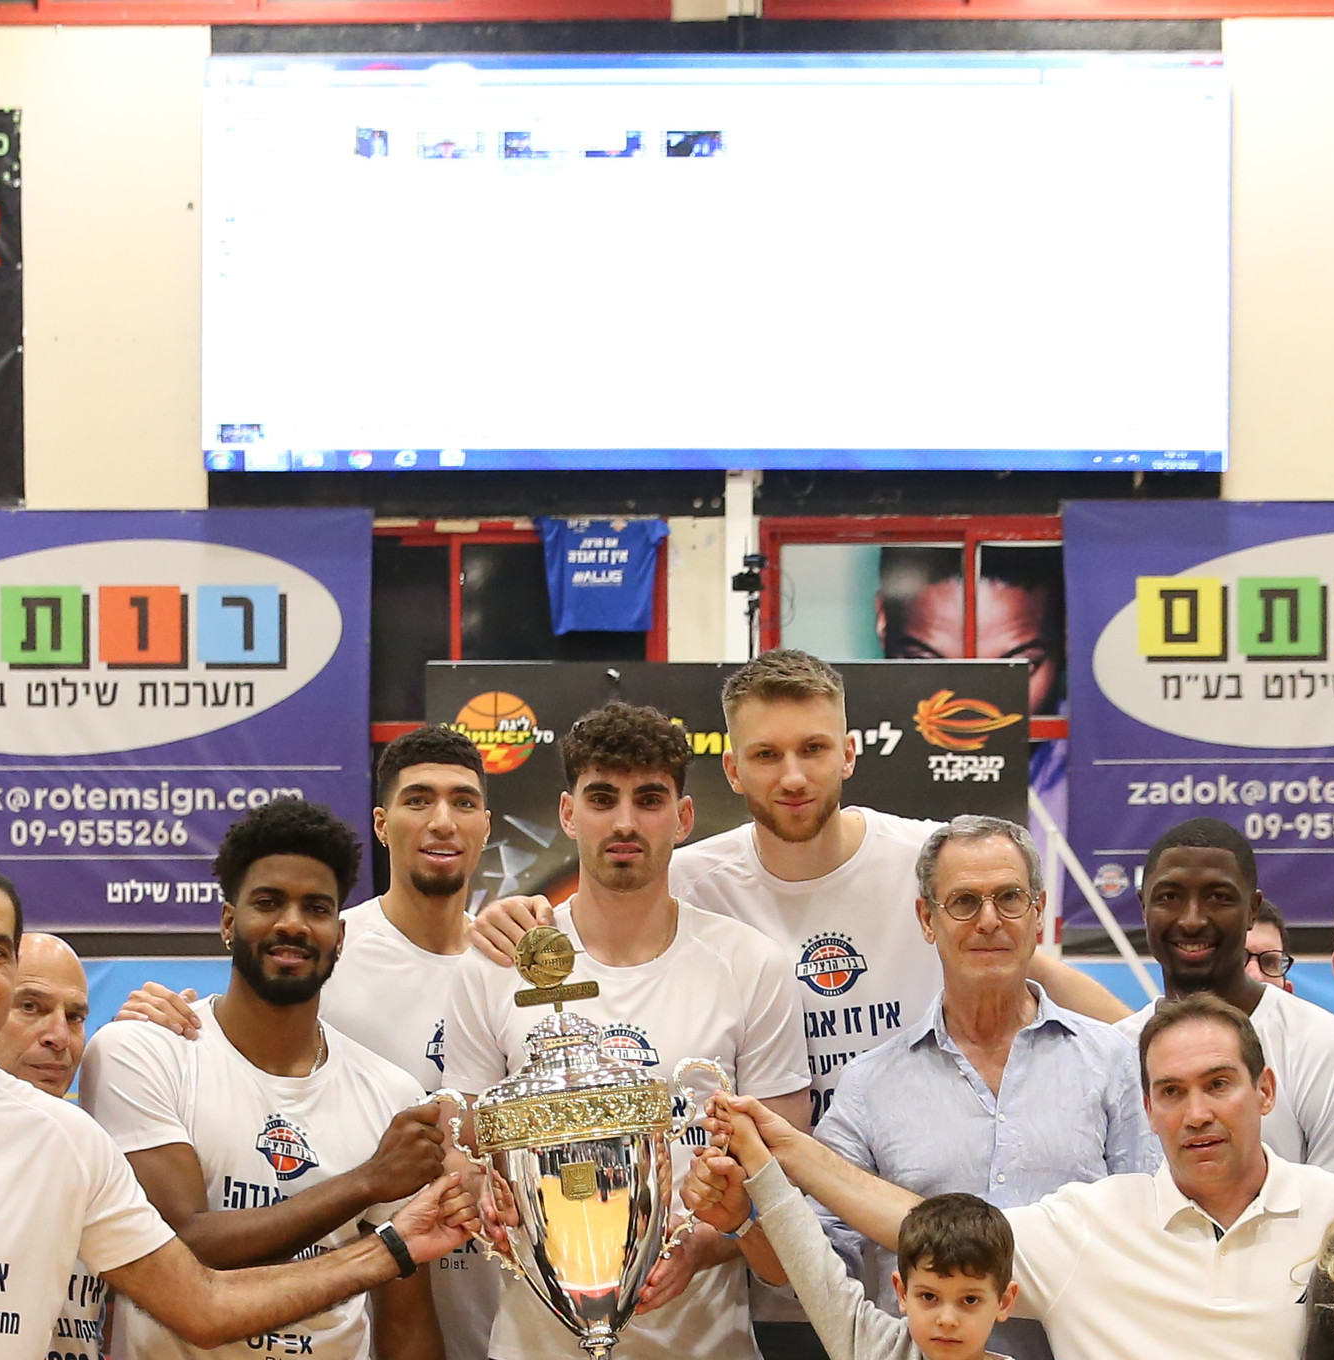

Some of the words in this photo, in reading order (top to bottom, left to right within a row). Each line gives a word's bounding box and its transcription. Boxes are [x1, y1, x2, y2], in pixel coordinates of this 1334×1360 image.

[27, 677, 117, 708] שילוט
[138, 681, 254, 708] מערכות
[928, 752, 1005, 769] מנהלת
[933, 766, 1000, 782] הליגה
[11, 820, 188, 847] 09-9555266
[107, 880, 170, 903] שילוט
[176, 882, 224, 903] רכות
[803, 959, 838, 975] הרצליה
[842, 957, 859, 968] בני
[805, 1010, 836, 1038] אג
[843, 1007, 862, 1035] זו
[869, 1001, 901, 1036] אין
[440, 1258, 468, 1270] Dist.
